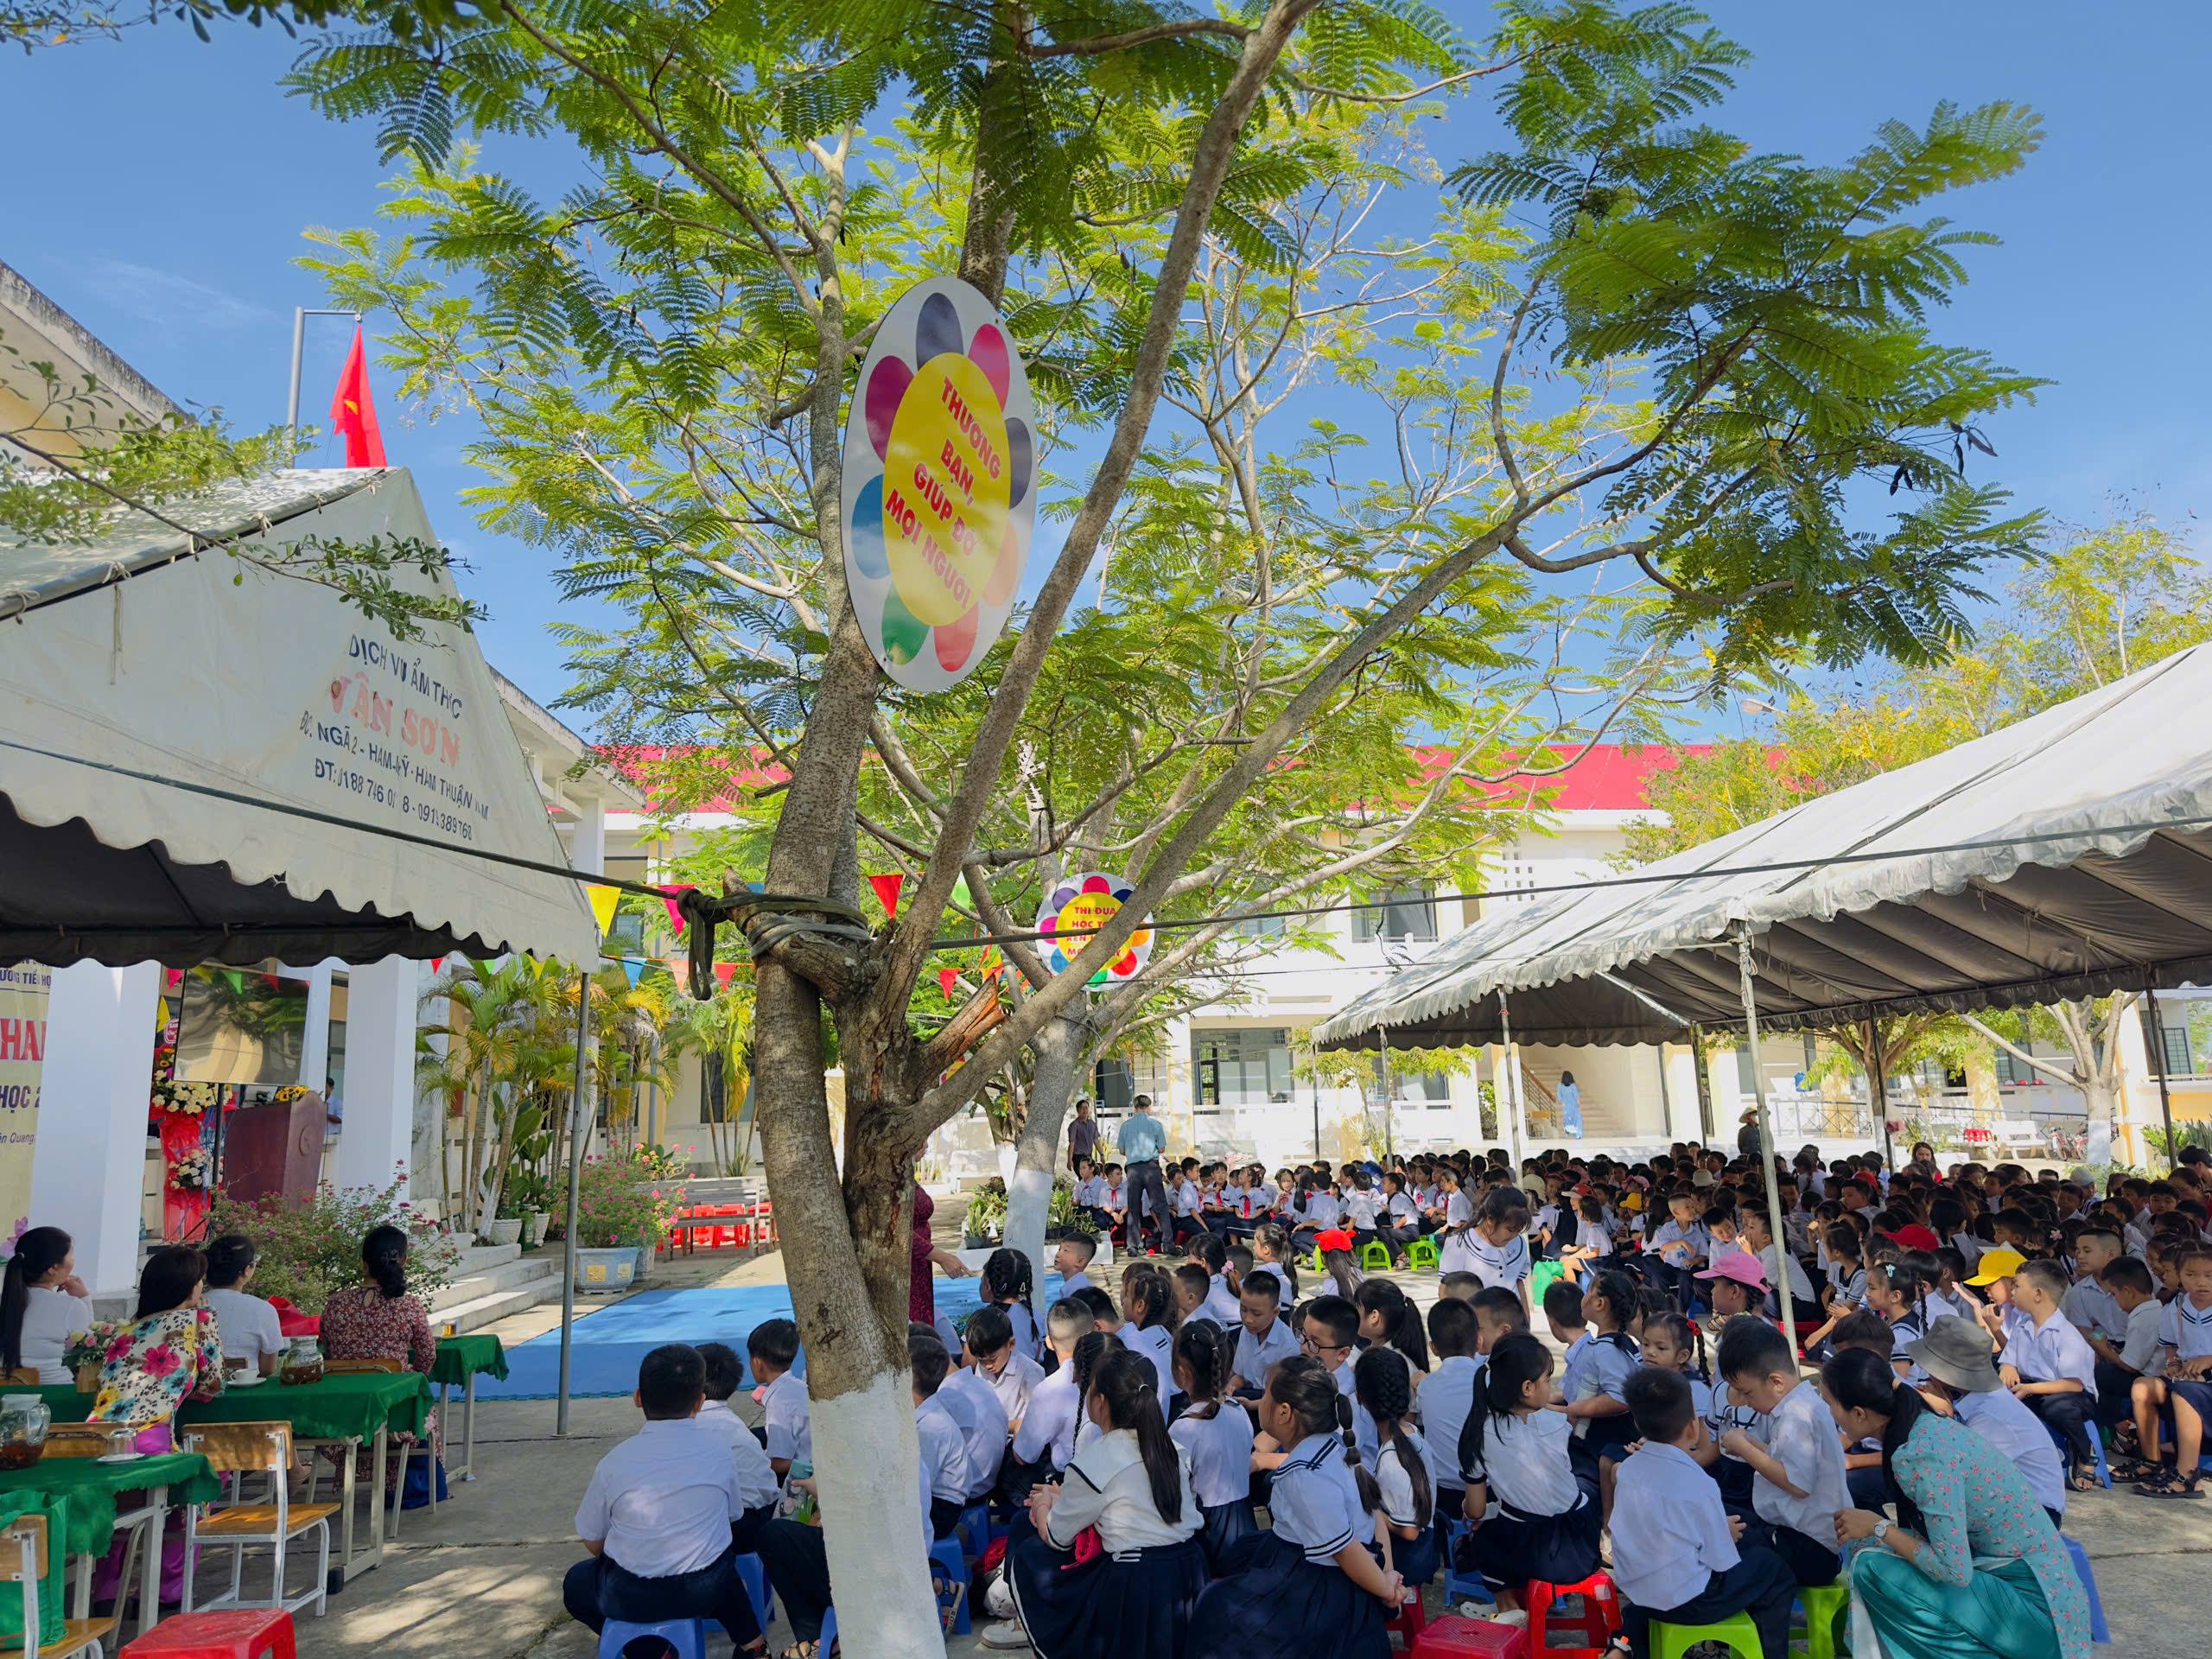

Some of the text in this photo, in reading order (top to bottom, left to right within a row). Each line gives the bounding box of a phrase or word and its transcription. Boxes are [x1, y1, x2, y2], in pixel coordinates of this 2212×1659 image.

[885, 489, 923, 546] MỌI
[913, 463, 953, 521] GIÚP
[349, 634, 387, 671] DỊCH
[410, 658, 429, 696] ẨM
[317, 721, 350, 751] NGÃ
[440, 779, 473, 809] THUẬN
[401, 708, 461, 768] SƠN
[1074, 906, 1091, 915] THI
